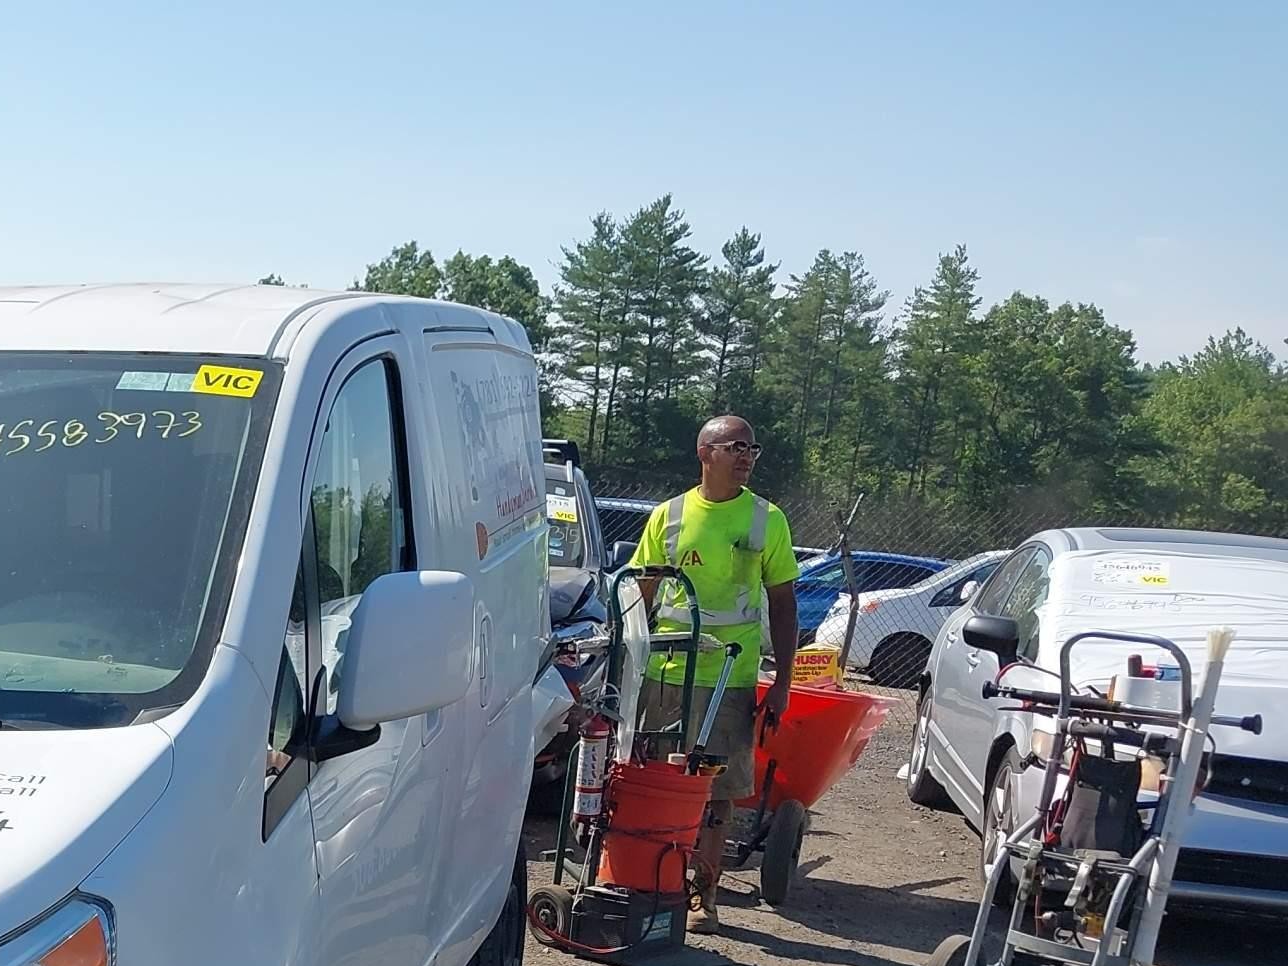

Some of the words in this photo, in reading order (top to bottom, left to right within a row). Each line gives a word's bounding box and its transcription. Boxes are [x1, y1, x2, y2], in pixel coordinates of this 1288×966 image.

[203, 372, 255, 391] VIC
[556, 511, 576, 521] VIC
[1142, 576, 1169, 584] VIC
